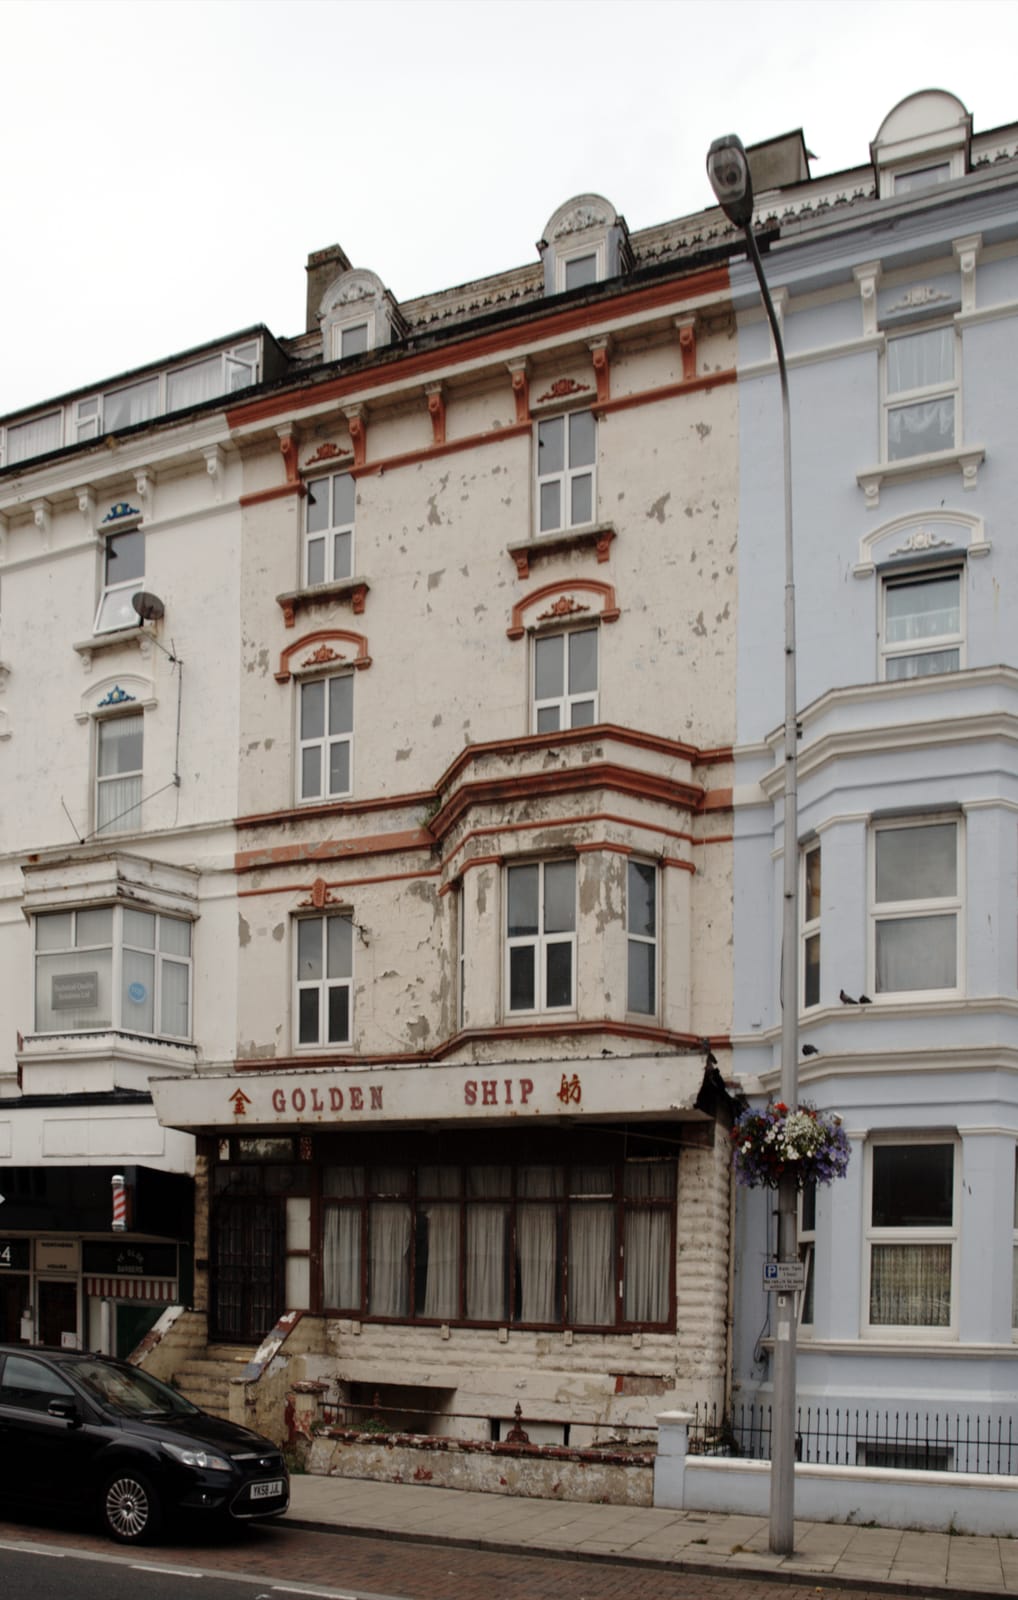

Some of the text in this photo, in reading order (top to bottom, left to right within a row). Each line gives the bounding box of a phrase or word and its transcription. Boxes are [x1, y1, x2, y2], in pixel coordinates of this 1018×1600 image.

[228, 1087, 251, 1115] 金
[272, 1078, 534, 1113] GOLDEN SHIP
[768, 1266, 777, 1278] P
